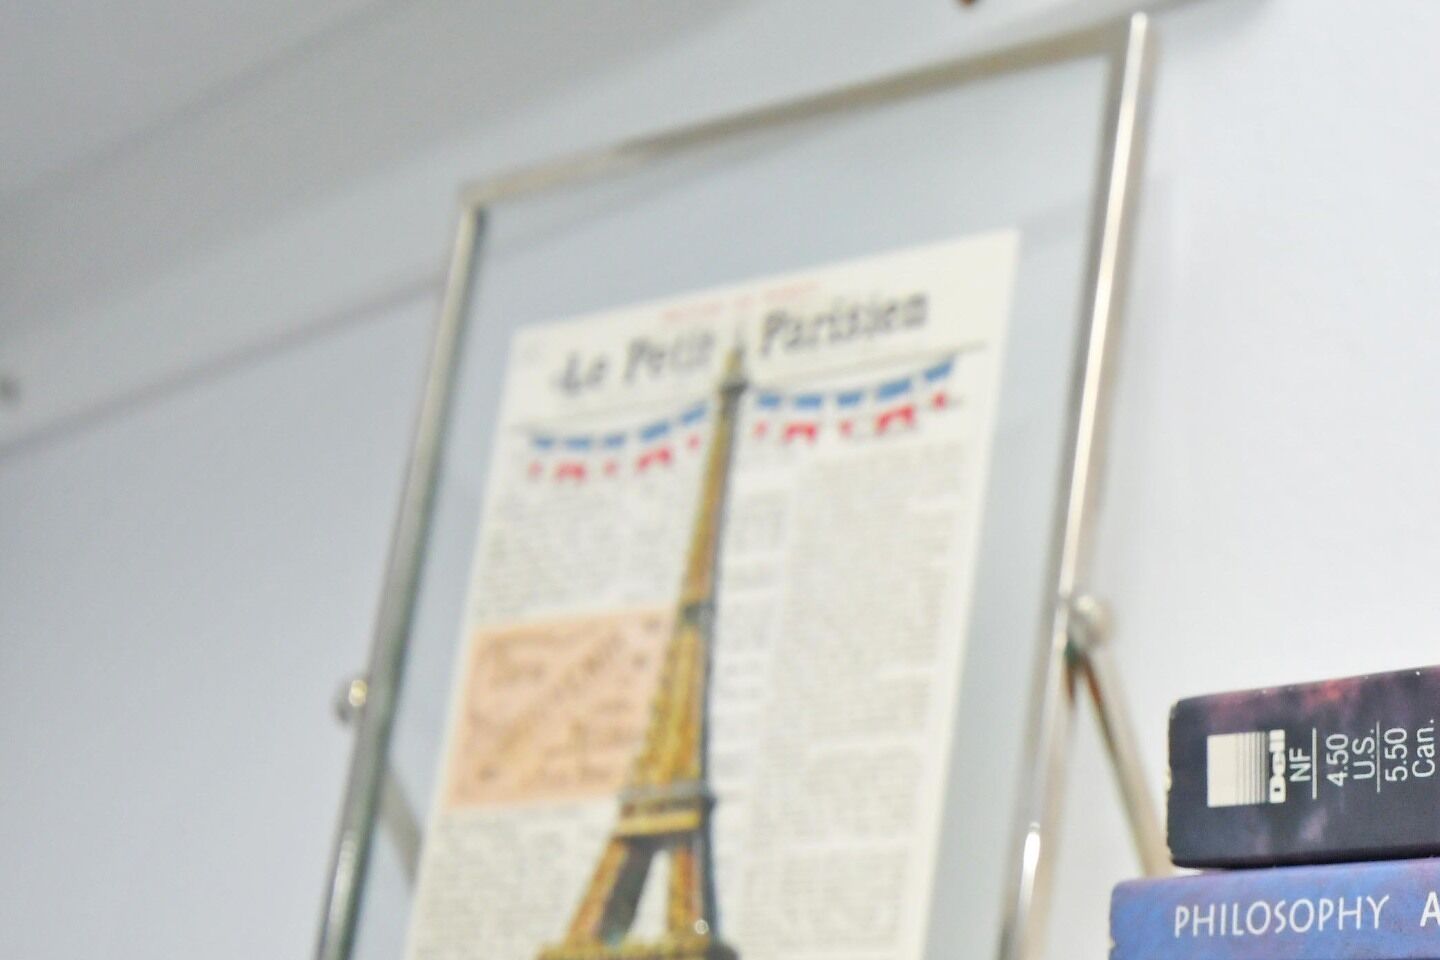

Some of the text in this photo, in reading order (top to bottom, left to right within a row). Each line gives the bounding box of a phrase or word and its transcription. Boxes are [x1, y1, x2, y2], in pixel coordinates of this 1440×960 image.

[1289, 748, 1311, 782] NF
[1326, 733, 1348, 787] 4.50
[1352, 728, 1376, 780] U.S.
[1385, 727, 1408, 782] 5.50
[1411, 719, 1436, 779] Can.
[1174, 895, 1390, 938] PHILOSOPHY
